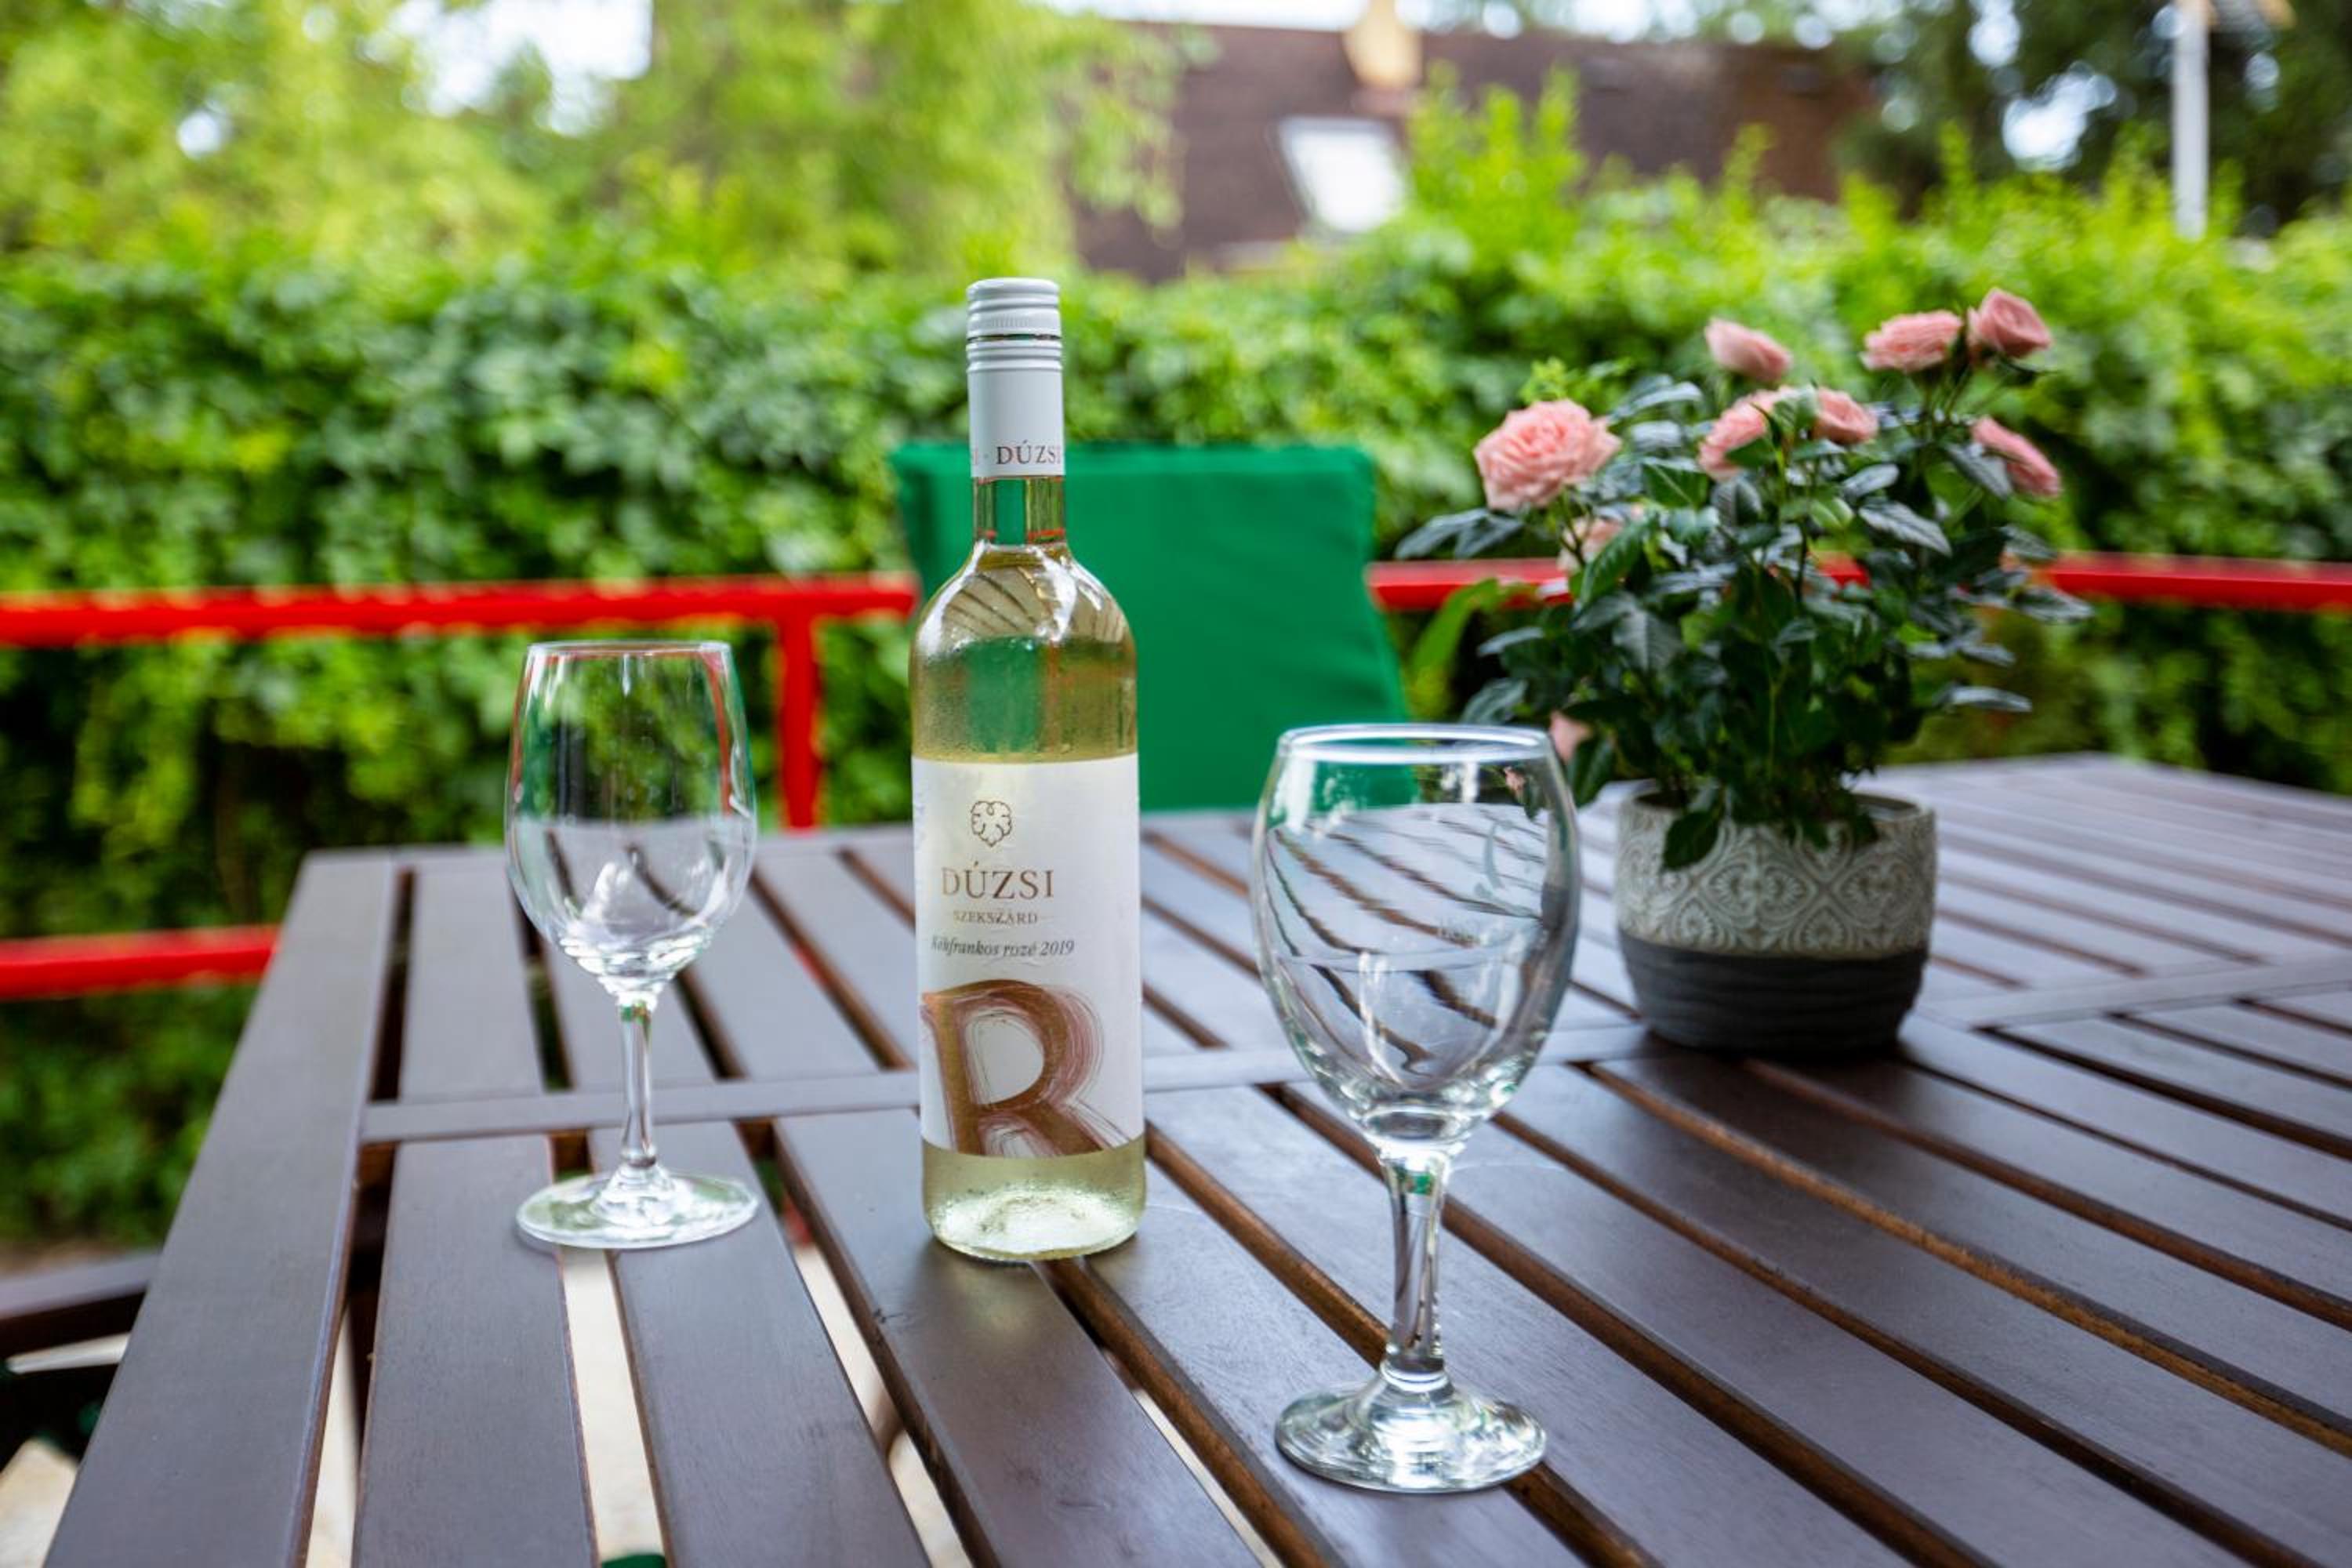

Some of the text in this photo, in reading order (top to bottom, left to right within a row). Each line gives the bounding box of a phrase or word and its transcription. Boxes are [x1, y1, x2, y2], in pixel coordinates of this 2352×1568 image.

[941, 861, 1054, 900] DÚZSI
[1040, 939, 1075, 956] 2019
[920, 978, 1131, 1158] R
